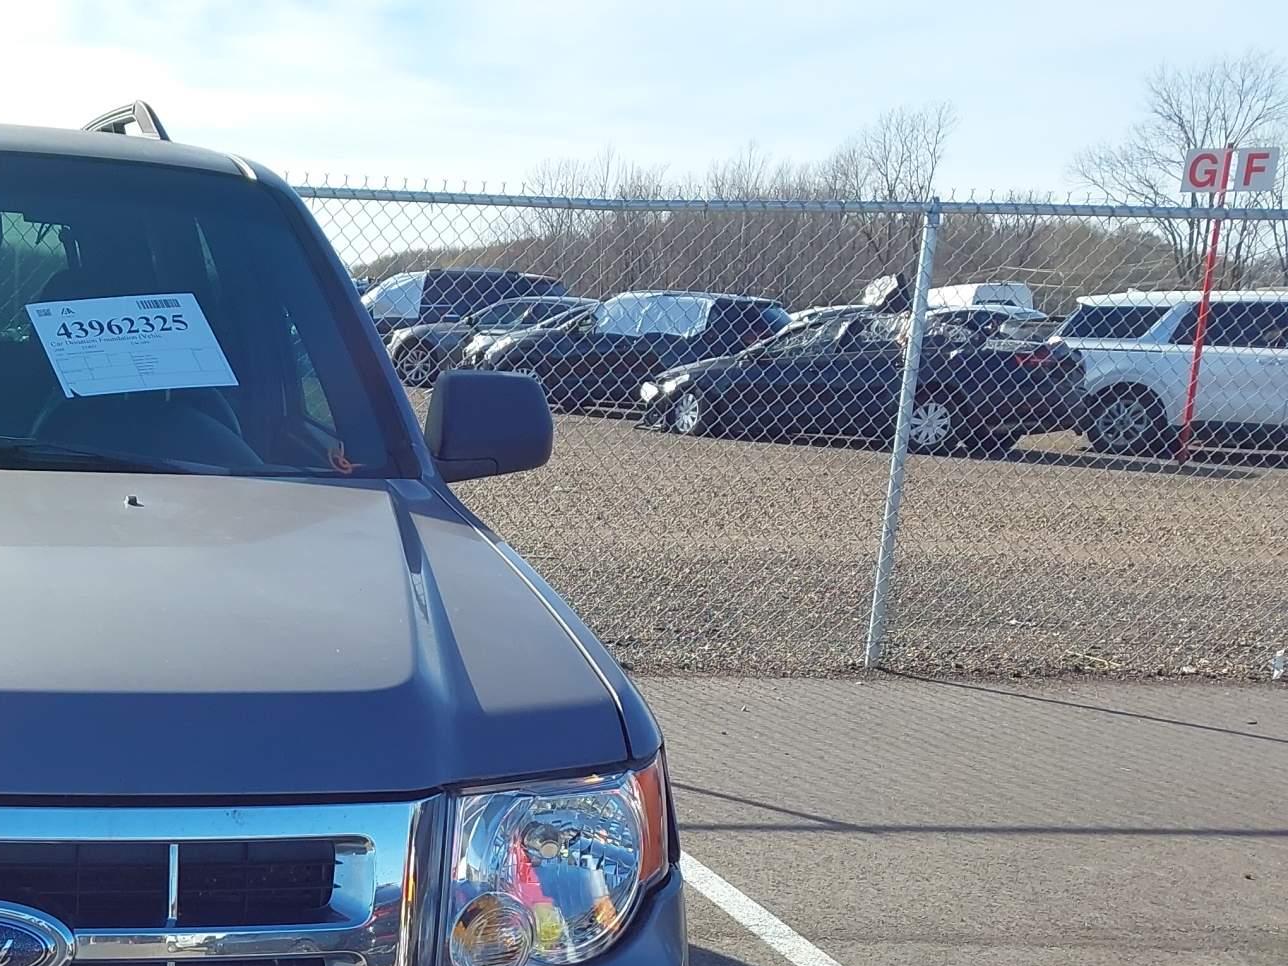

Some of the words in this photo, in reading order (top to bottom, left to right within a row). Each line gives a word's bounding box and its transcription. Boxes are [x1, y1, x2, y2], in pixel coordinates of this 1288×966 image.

[1189, 153, 1218, 188] G
[1243, 153, 1270, 186] F
[56, 314, 189, 339] 43962325
